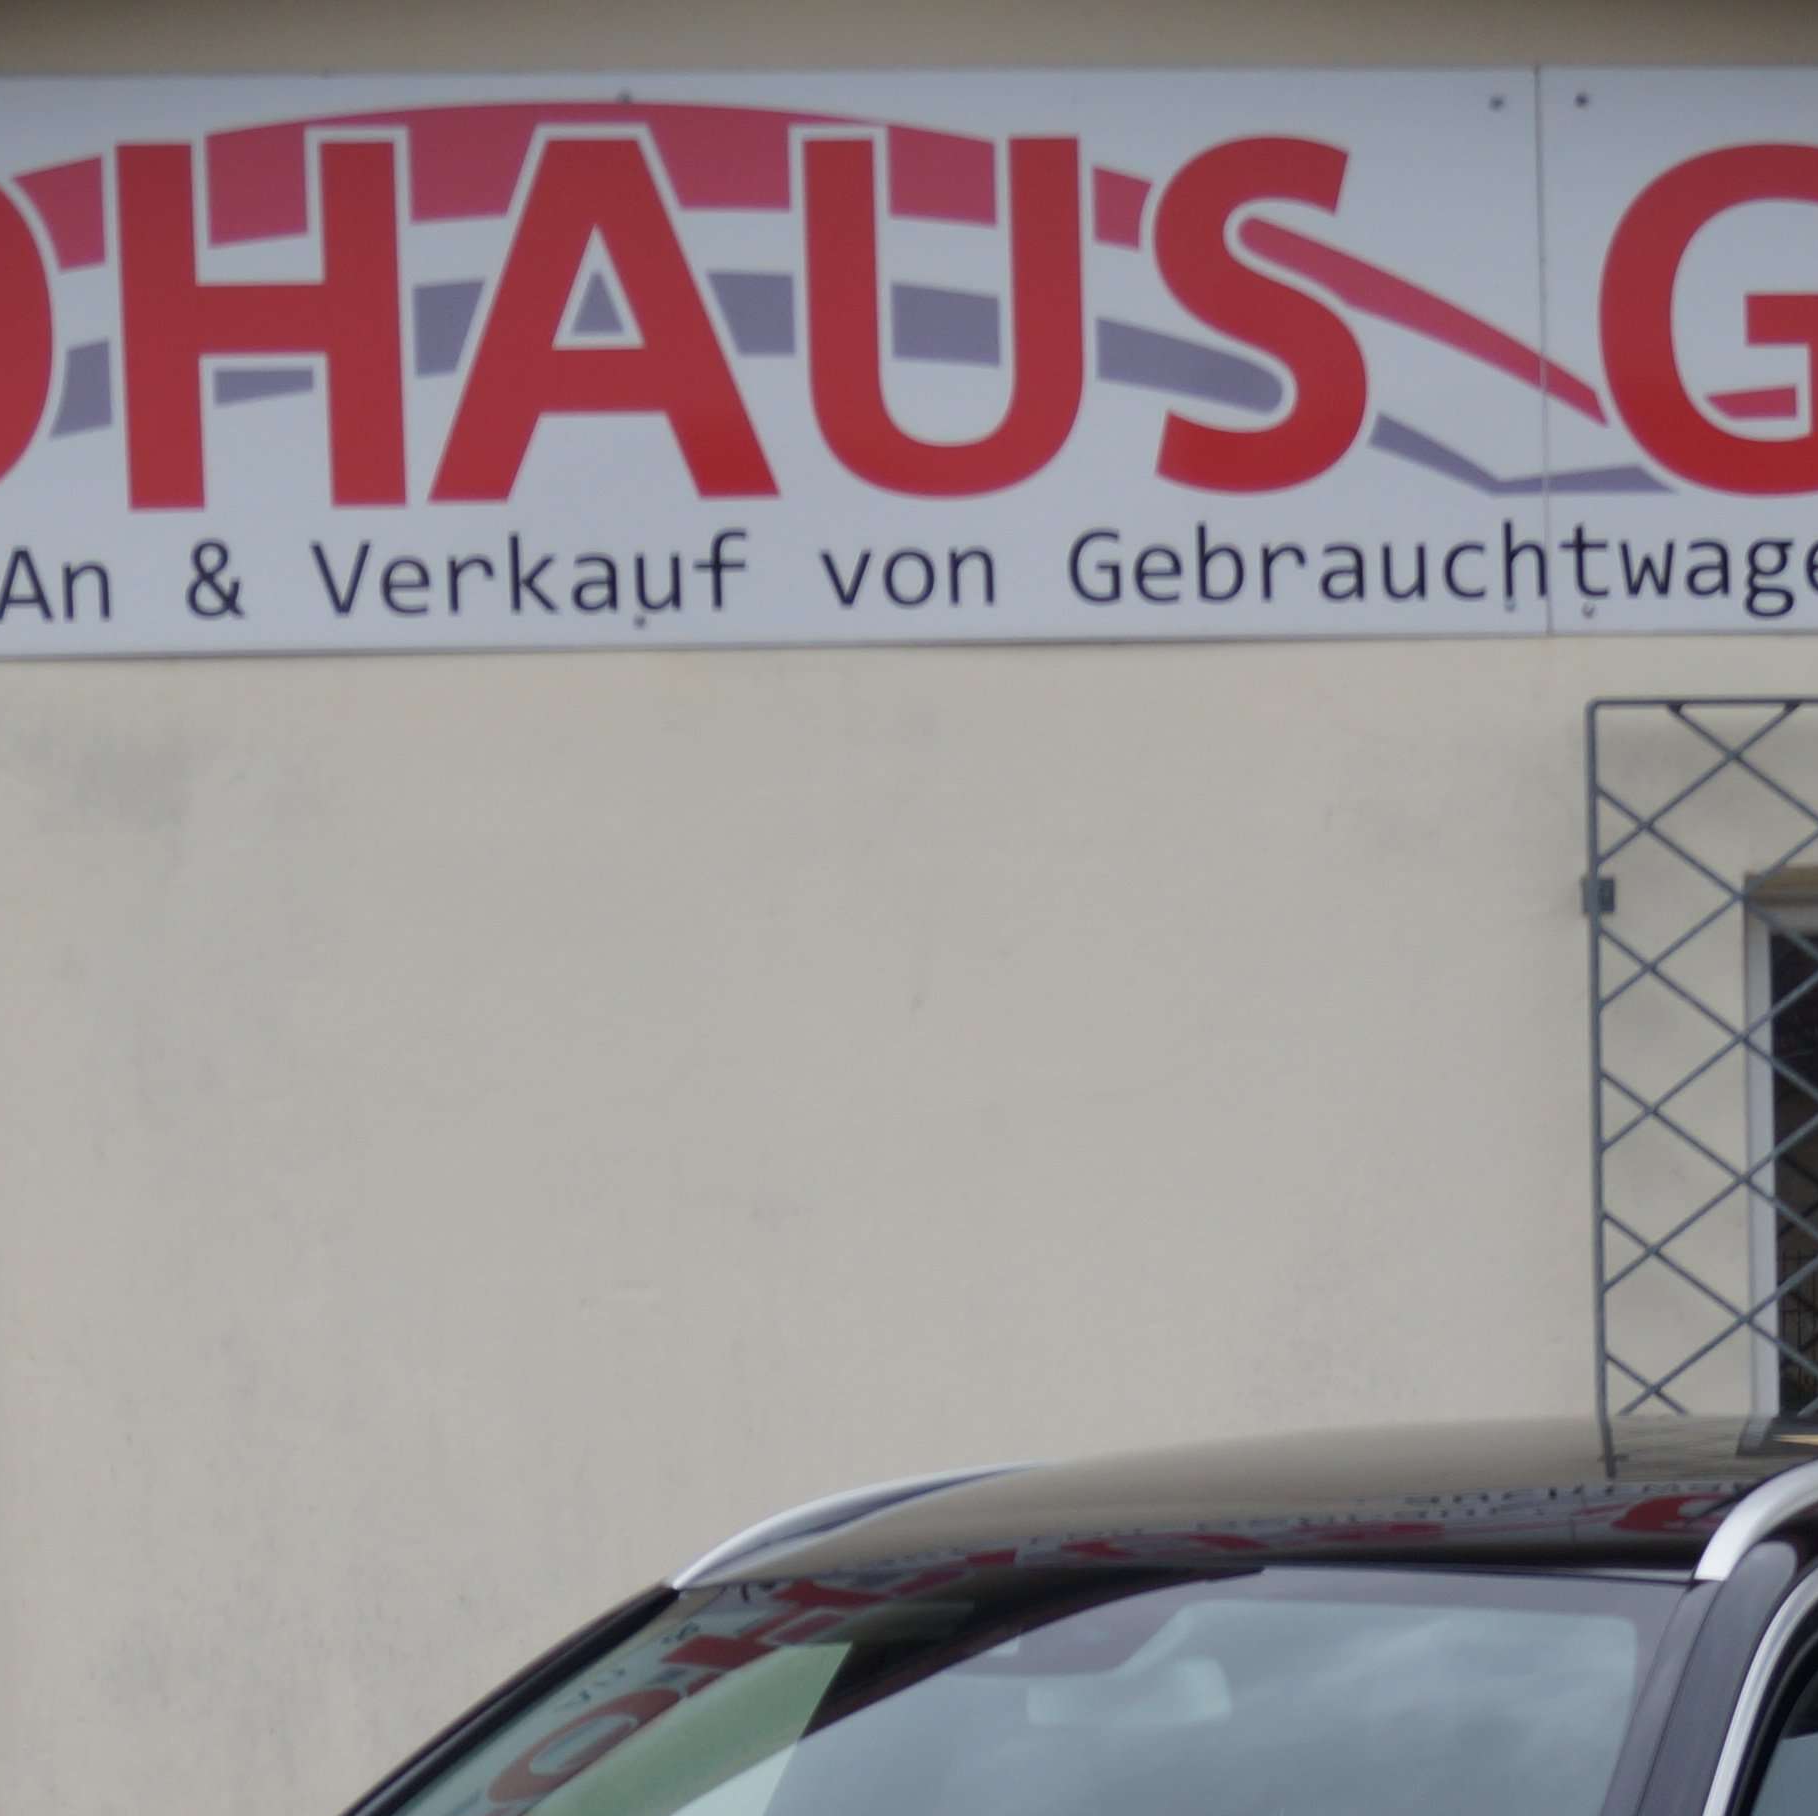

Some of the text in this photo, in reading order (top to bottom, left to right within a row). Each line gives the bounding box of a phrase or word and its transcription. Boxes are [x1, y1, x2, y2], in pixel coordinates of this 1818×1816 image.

[185, 540, 245, 618] &
[311, 529, 748, 616] Verkauf
[820, 549, 997, 607] von
